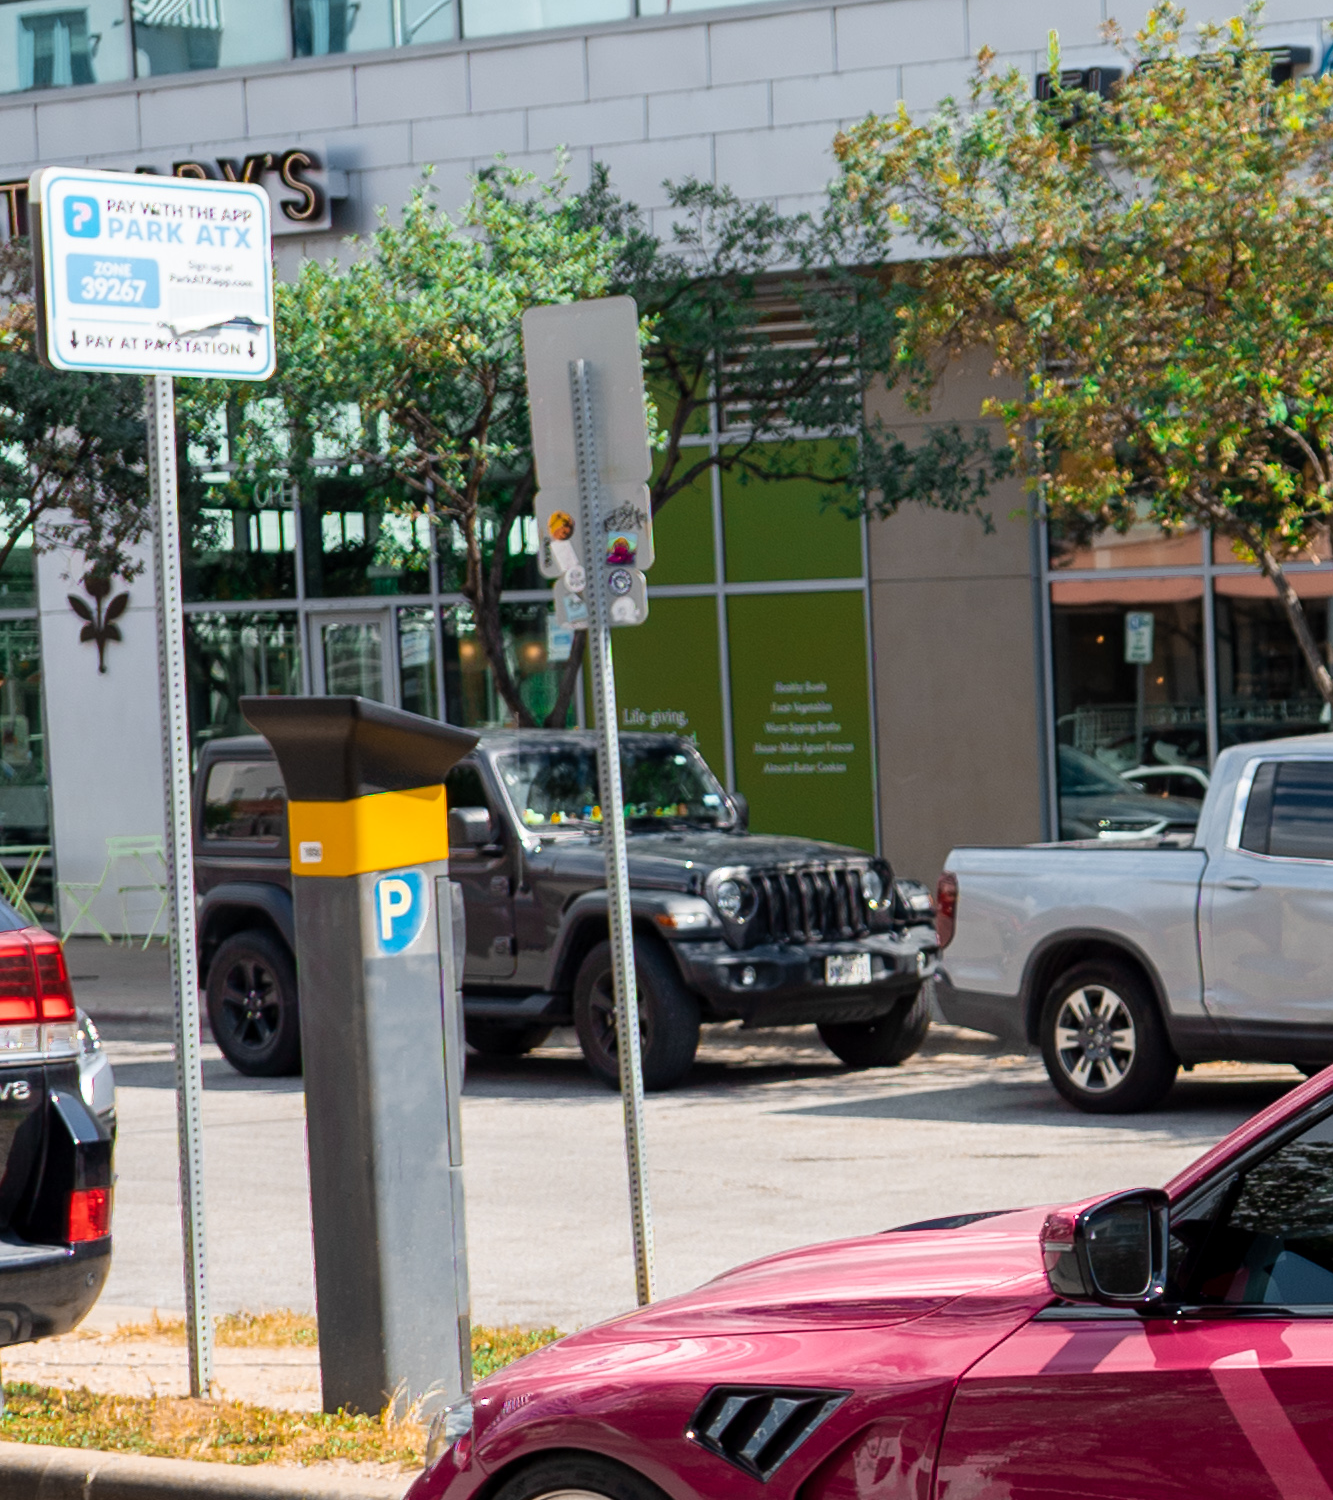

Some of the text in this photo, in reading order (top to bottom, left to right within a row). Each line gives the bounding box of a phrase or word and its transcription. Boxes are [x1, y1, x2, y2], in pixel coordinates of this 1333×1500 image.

[107, 199, 135, 213] PAY
[188, 204, 217, 220] THE
[221, 208, 252, 223] APP
[108, 217, 252, 249] PARK ATX
[94, 261, 132, 277] ZONE
[80, 276, 147, 303] 39267
[86, 335, 241, 355] PAY AT PAYSTATION
[622, 706, 689, 729] Life-giving,
[379, 879, 412, 940] P
